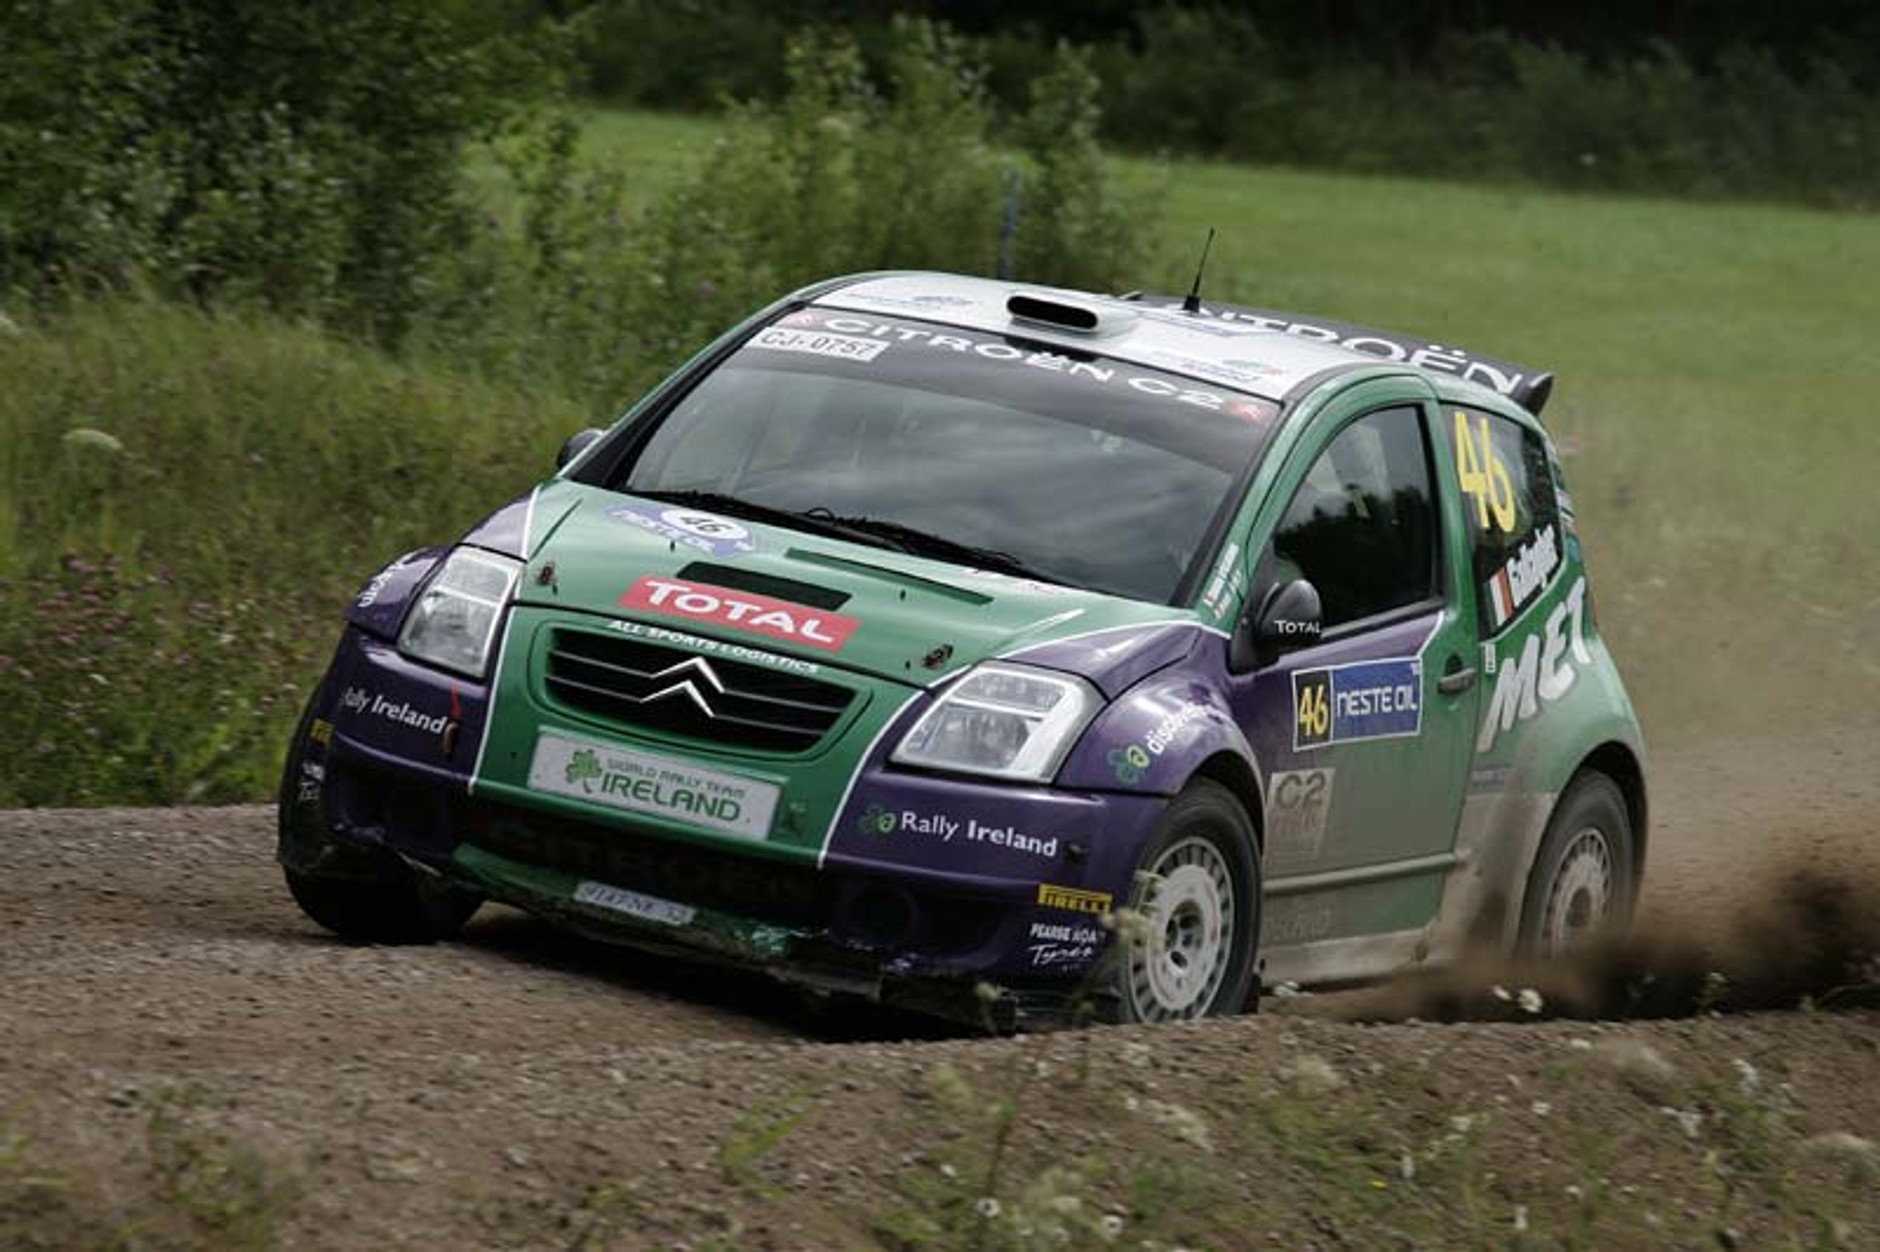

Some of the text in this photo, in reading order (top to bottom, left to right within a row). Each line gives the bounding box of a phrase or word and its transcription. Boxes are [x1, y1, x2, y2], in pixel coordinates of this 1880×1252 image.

[824, 318, 1224, 411] CITROËN C2
[1454, 411, 1515, 532] 46
[679, 516, 733, 533] 46
[645, 579, 834, 644] TOTAL
[1274, 619, 1321, 635] TOTAL
[607, 619, 820, 674] ALL SPORTS LOGISTICS
[371, 694, 449, 735] Ireland
[1299, 683, 1418, 737] 46 NESTE OIL
[601, 771, 741, 822] IRELAND
[606, 756, 746, 800] WORLD RALLY TEAM
[1276, 770, 1327, 810] C2
[900, 811, 1058, 857] Rally Ireland
[1038, 883, 1113, 914] PIRELLI
